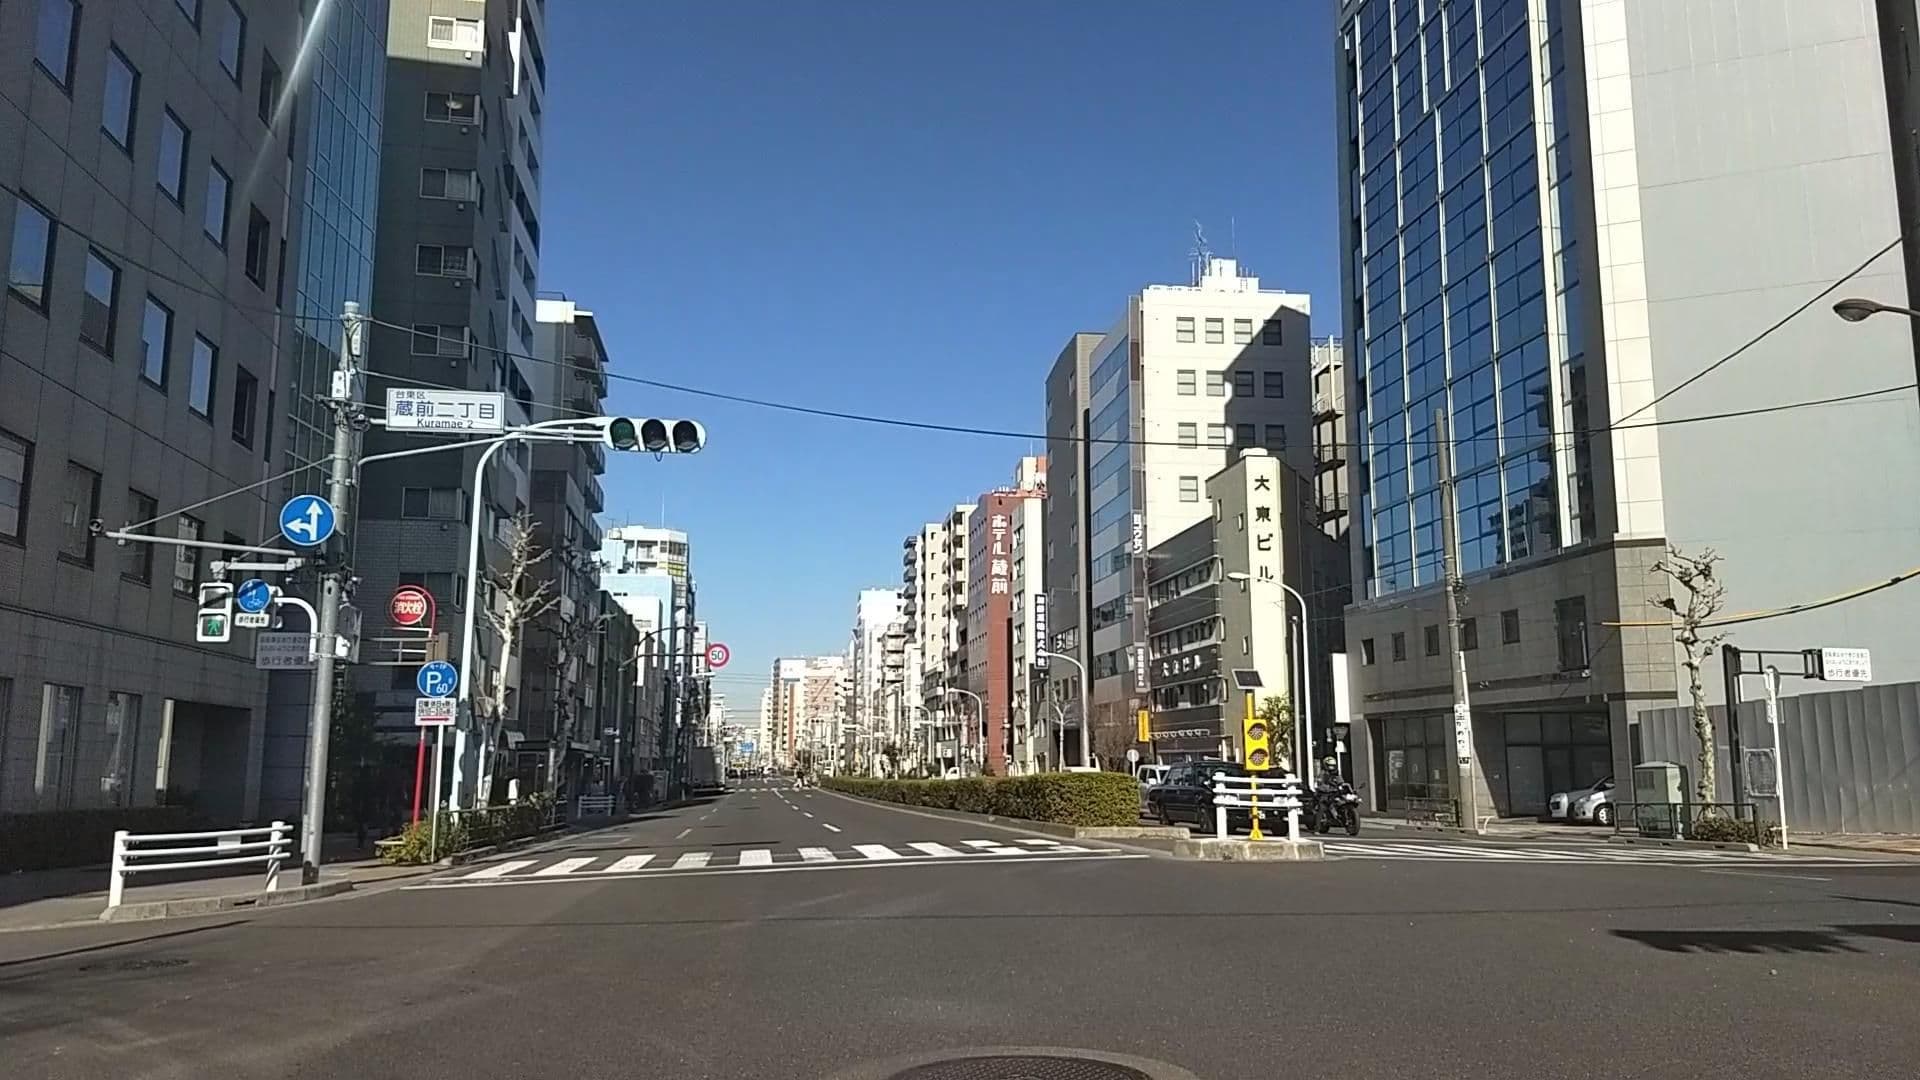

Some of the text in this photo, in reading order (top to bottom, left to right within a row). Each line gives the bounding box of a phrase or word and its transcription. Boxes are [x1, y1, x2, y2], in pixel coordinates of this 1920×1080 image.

[395, 391, 426, 400] 台東区
[395, 400, 495, 419] 蔵前二丁目
[417, 420, 474, 429] Kuramae 2
[1254, 475, 1274, 582] 大東ビル
[394, 601, 422, 615] 消火栓
[711, 650, 724, 660] 50
[426, 671, 442, 694] P
[436, 683, 448, 694] 60
